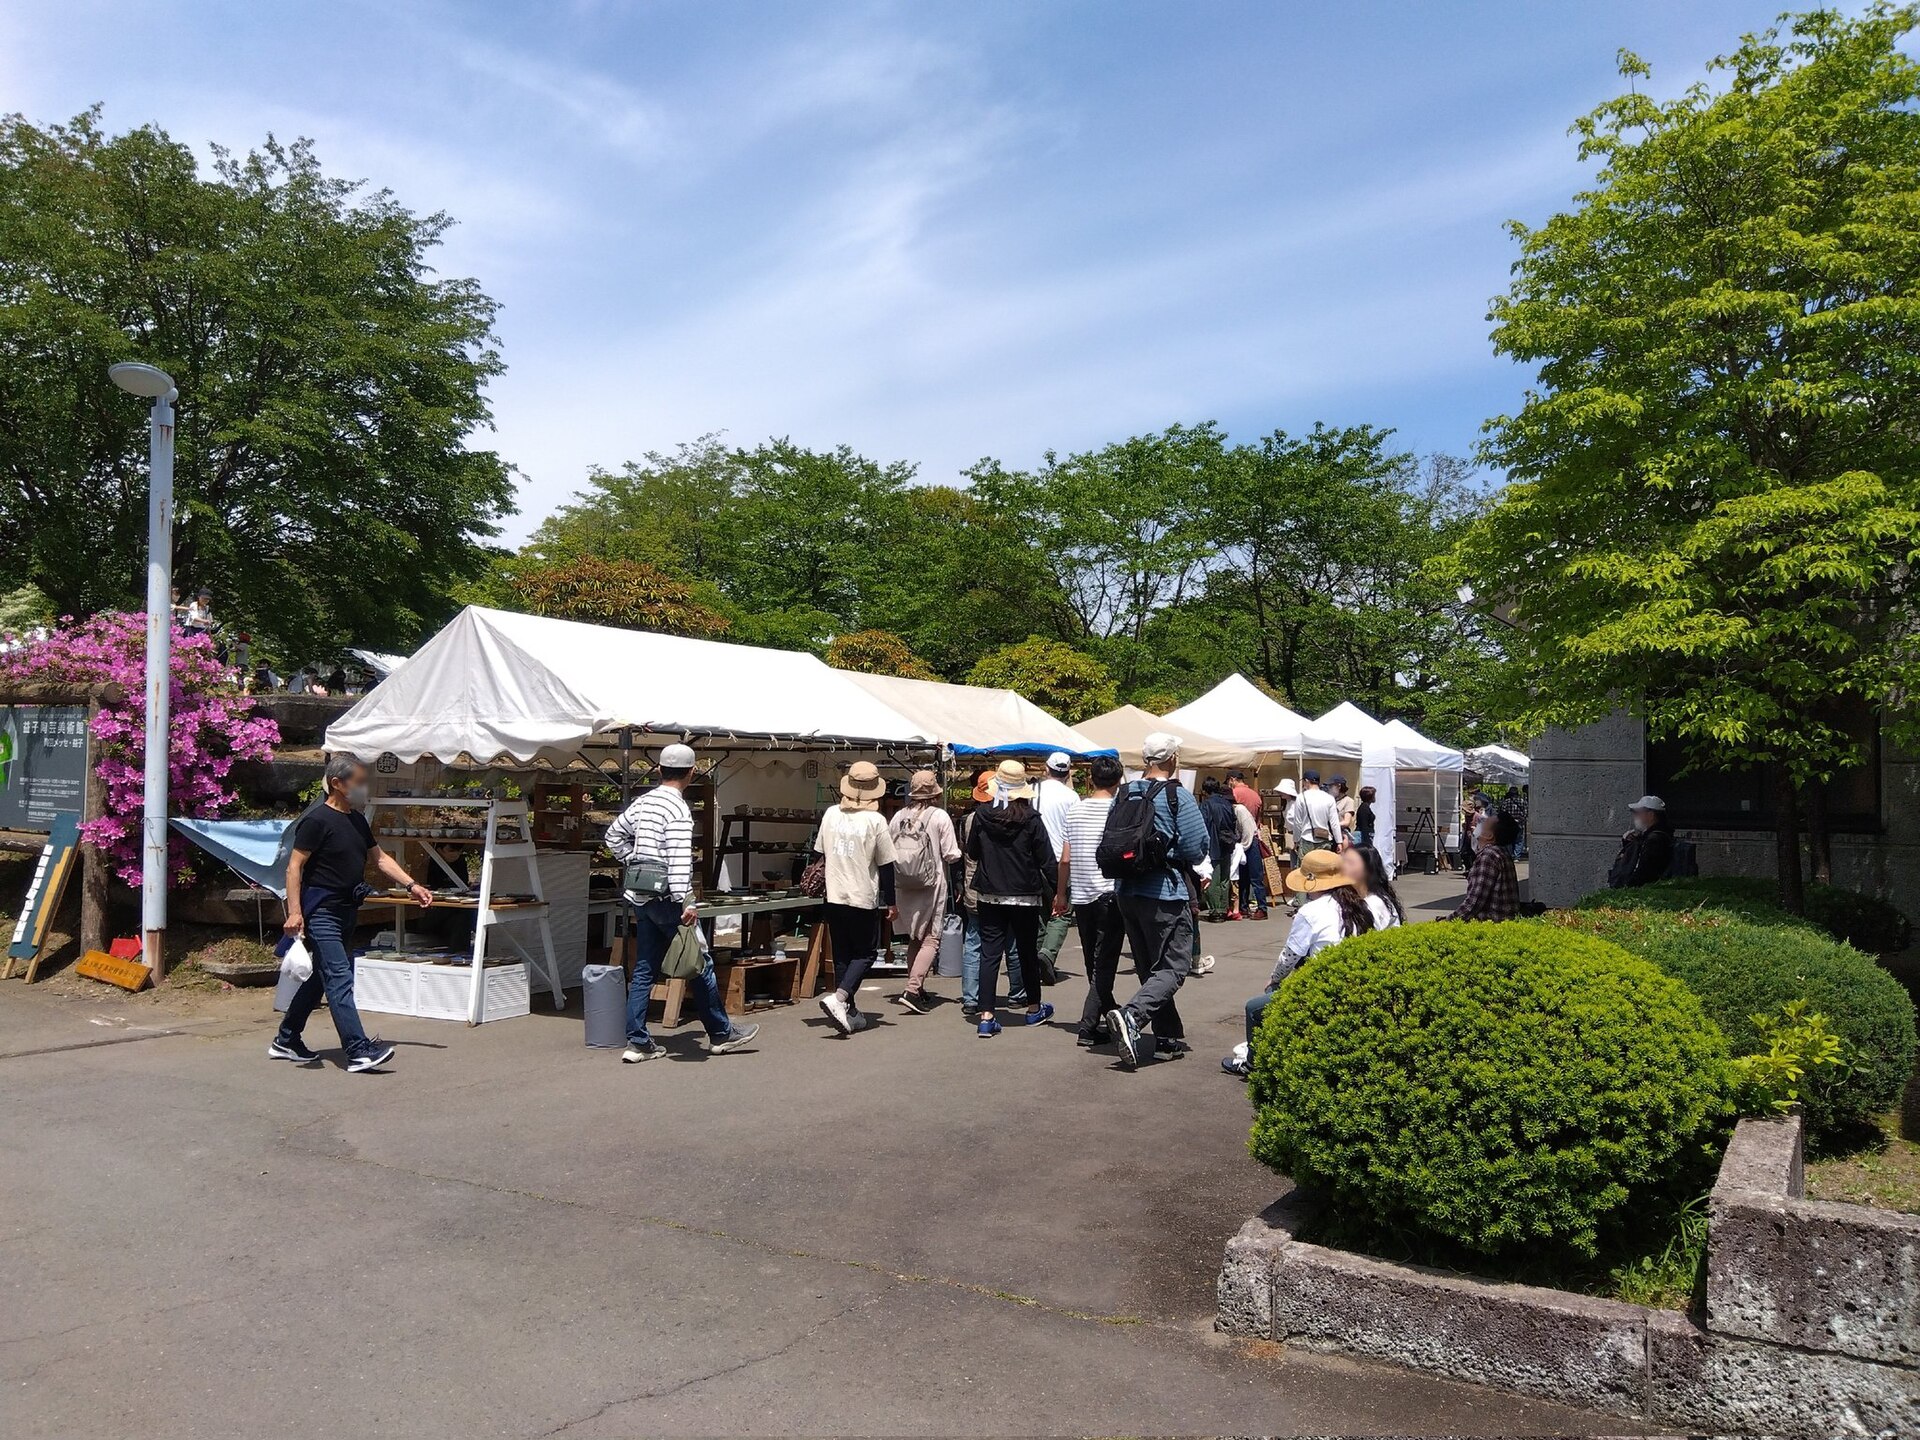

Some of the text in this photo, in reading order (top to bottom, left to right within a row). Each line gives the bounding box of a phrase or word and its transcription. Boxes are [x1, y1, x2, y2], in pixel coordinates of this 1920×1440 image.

[23, 721, 84, 735] 益子陶芸美術館
